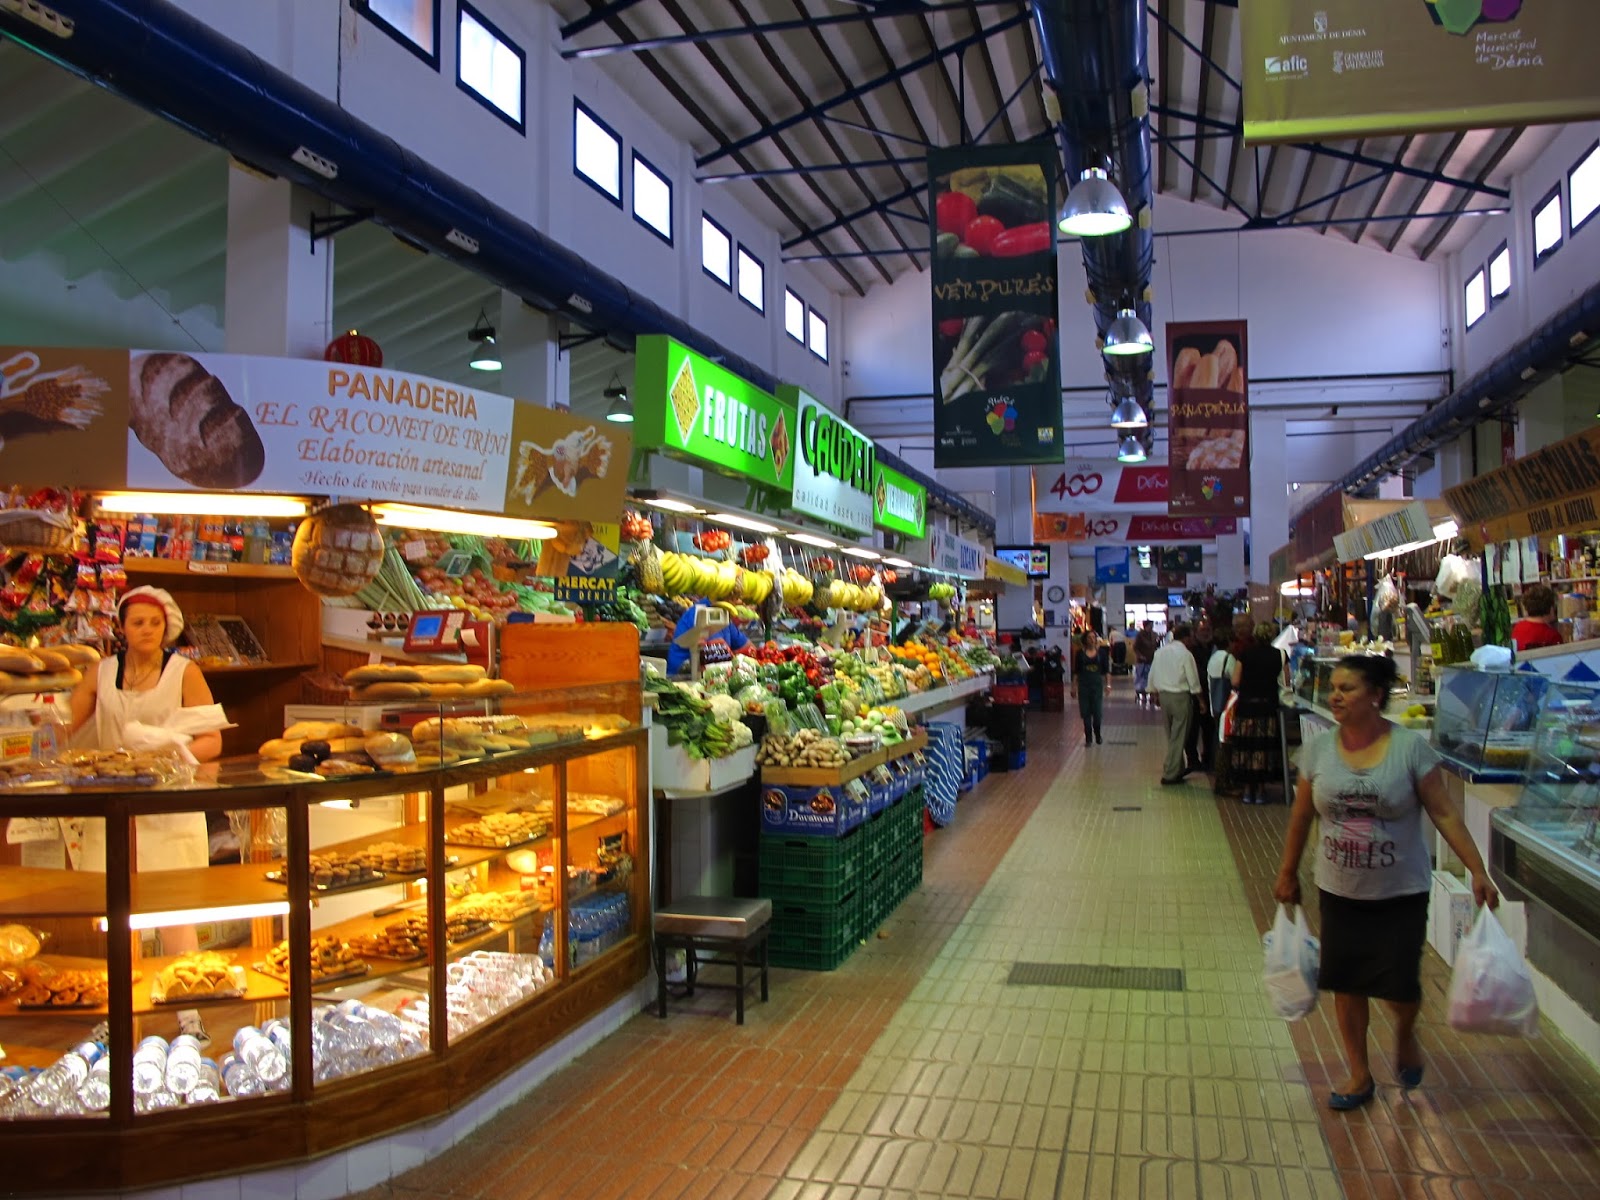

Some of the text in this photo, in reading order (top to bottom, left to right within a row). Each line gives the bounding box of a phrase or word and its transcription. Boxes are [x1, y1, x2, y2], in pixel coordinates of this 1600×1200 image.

[1280, 32, 1327, 45] AJUNTAMENT
[1329, 31, 1339, 39] DE
[1475, 37, 1537, 54] Municipal
[1476, 28, 1521, 42] Mercat
[1282, 55, 1308, 71] afic
[1476, 51, 1544, 71] de Dénia
[328, 369, 478, 421] PANADERIA
[255, 402, 299, 427] EL
[308, 403, 433, 442] RACONET
[433, 421, 460, 447] DE
[703, 384, 767, 461] FRUTAS
[297, 437, 488, 481] Elaboración artesanal
[352, 472, 368, 489] de
[371, 476, 400, 492] noche
[402, 482, 422, 498] para
[424, 483, 451, 499] vender
[452, 485, 464, 500] de
[1050, 472, 1103, 501] 400
[796, 488, 829, 512] calidad
[833, 501, 853, 522] desde
[1085, 518, 1119, 539] 400
[558, 576, 616, 590] MERCAT
[557, 589, 571, 601] DE
